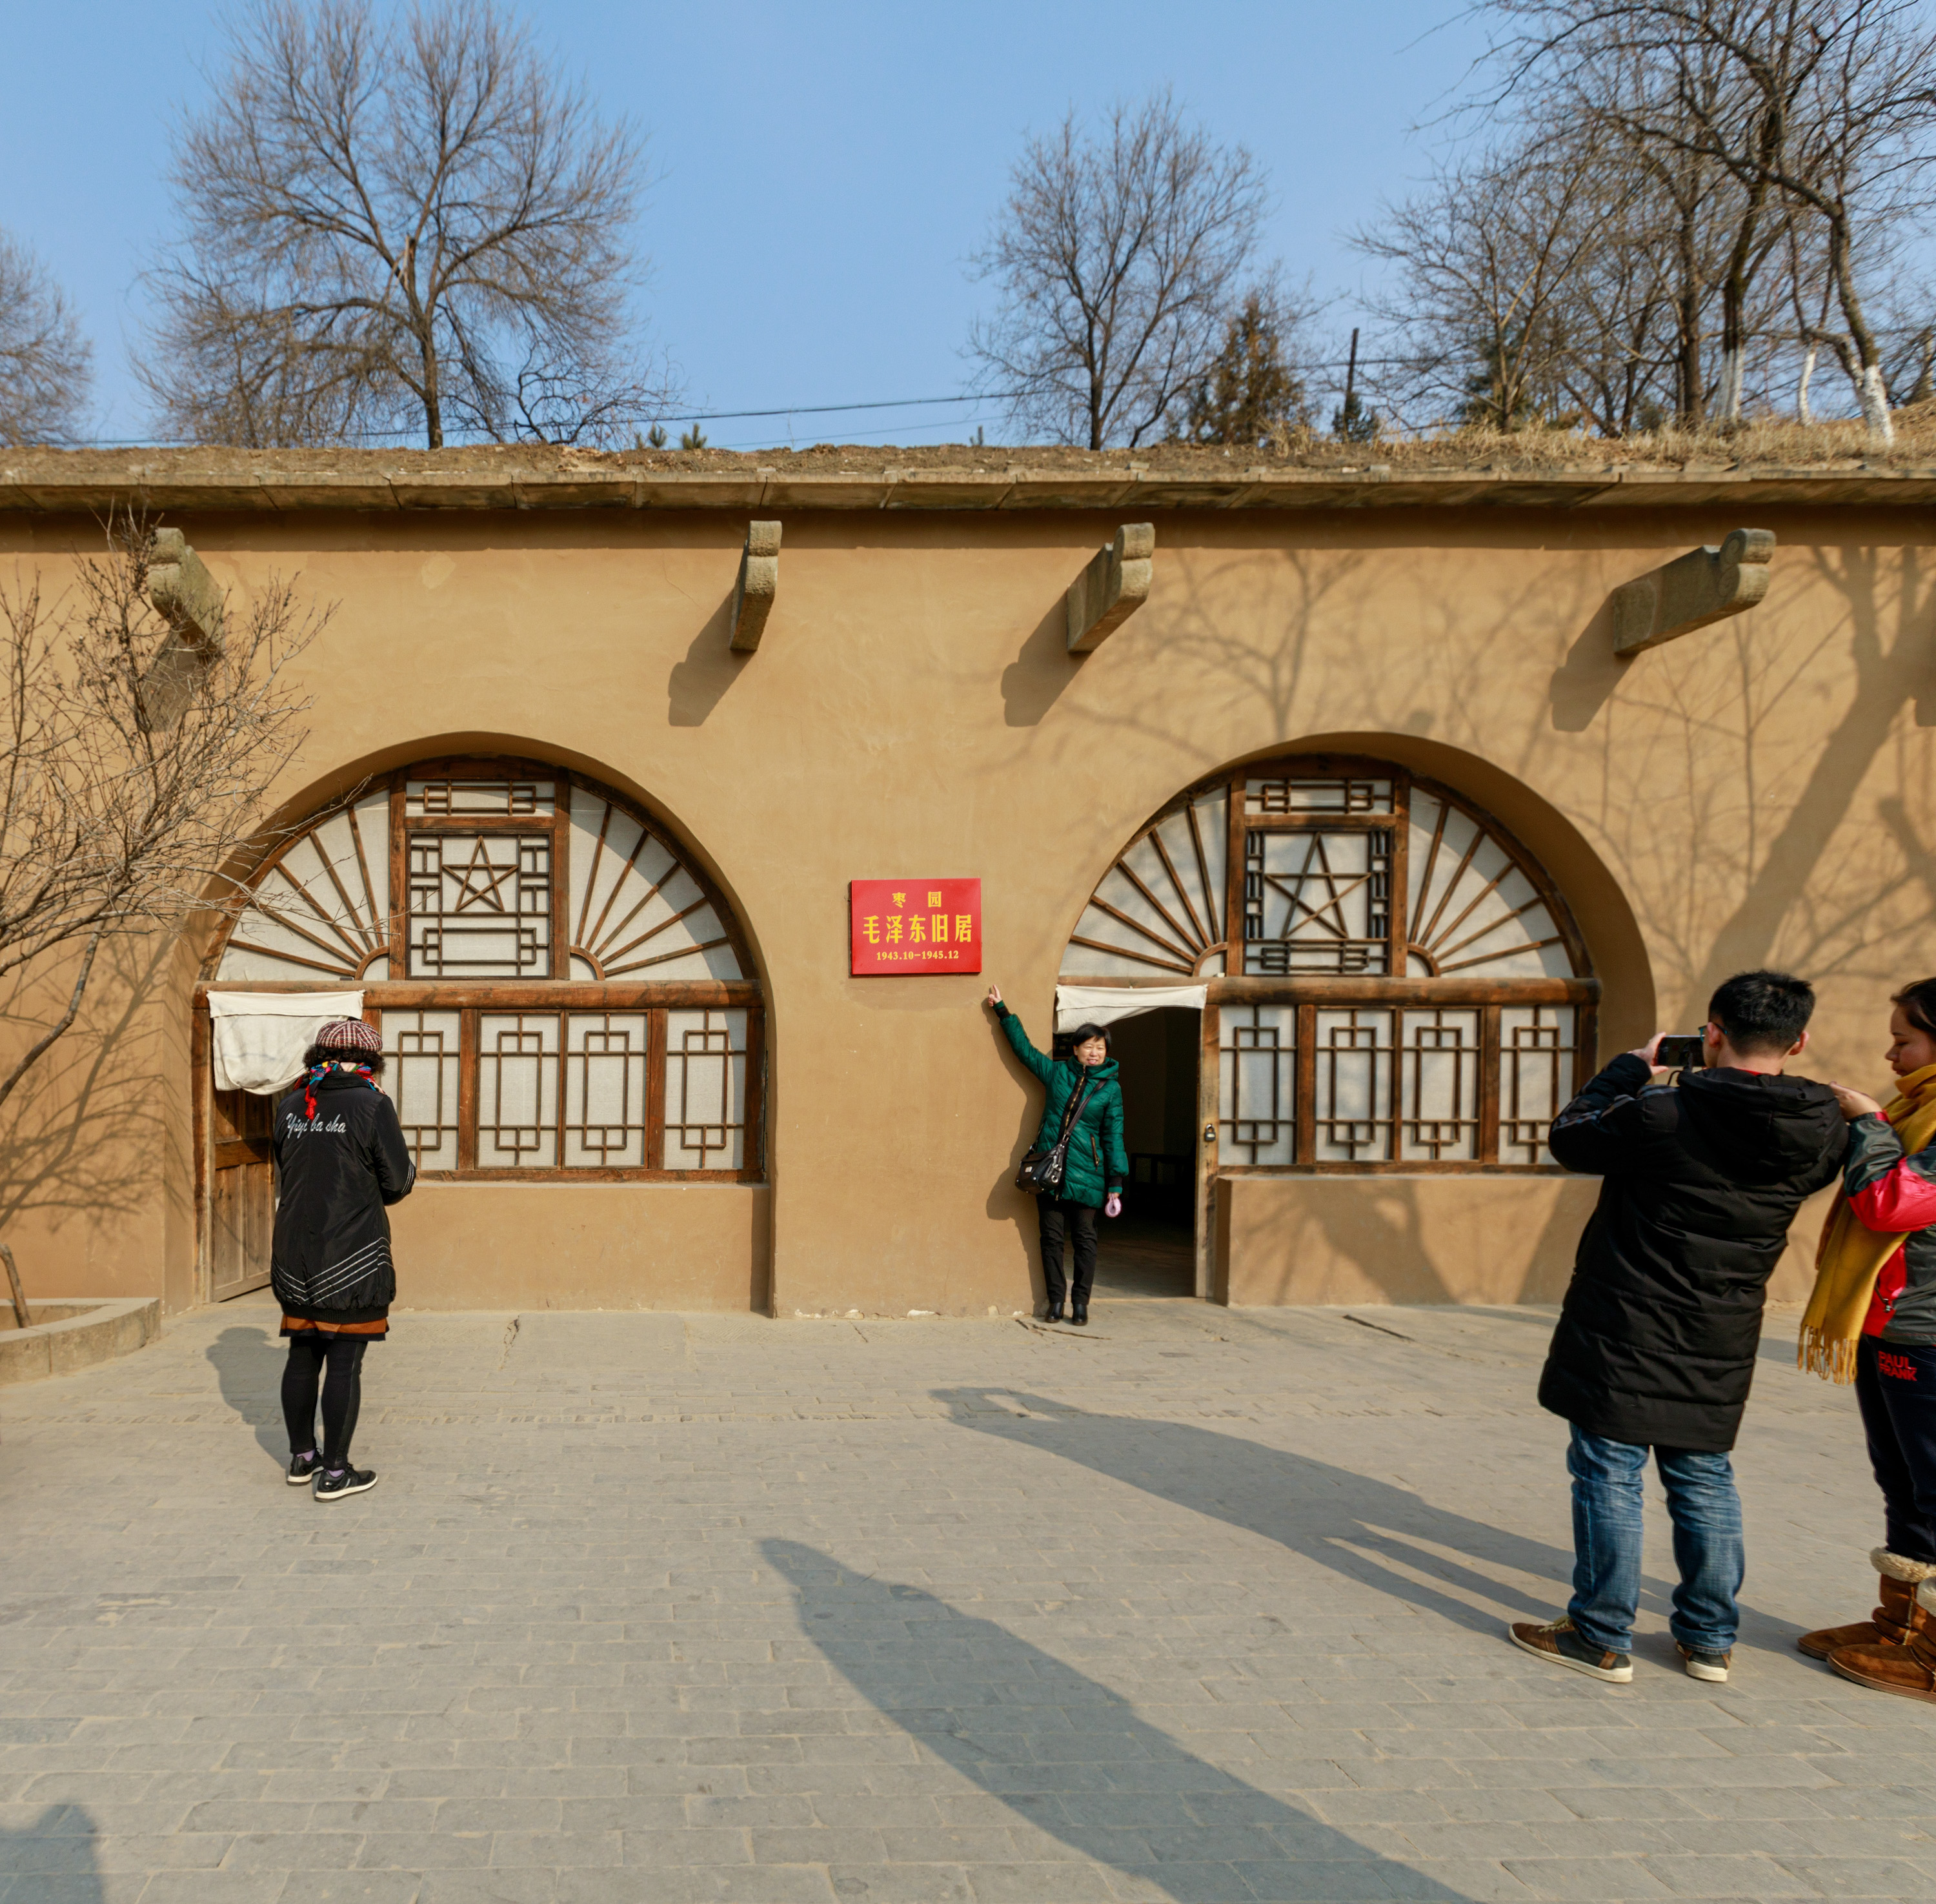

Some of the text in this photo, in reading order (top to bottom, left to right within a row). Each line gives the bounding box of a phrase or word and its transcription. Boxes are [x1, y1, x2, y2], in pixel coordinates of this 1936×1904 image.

[892, 891, 942, 908] 枣园
[863, 914, 972, 944] 毛泽东旧居
[876, 950, 959, 960] 1943.10-1945.12
[310, 1113, 323, 1132] ba
[325, 1113, 347, 1133] sha
[1878, 1350, 1917, 1370] PAUL
[1879, 1363, 1917, 1381] FRANK
